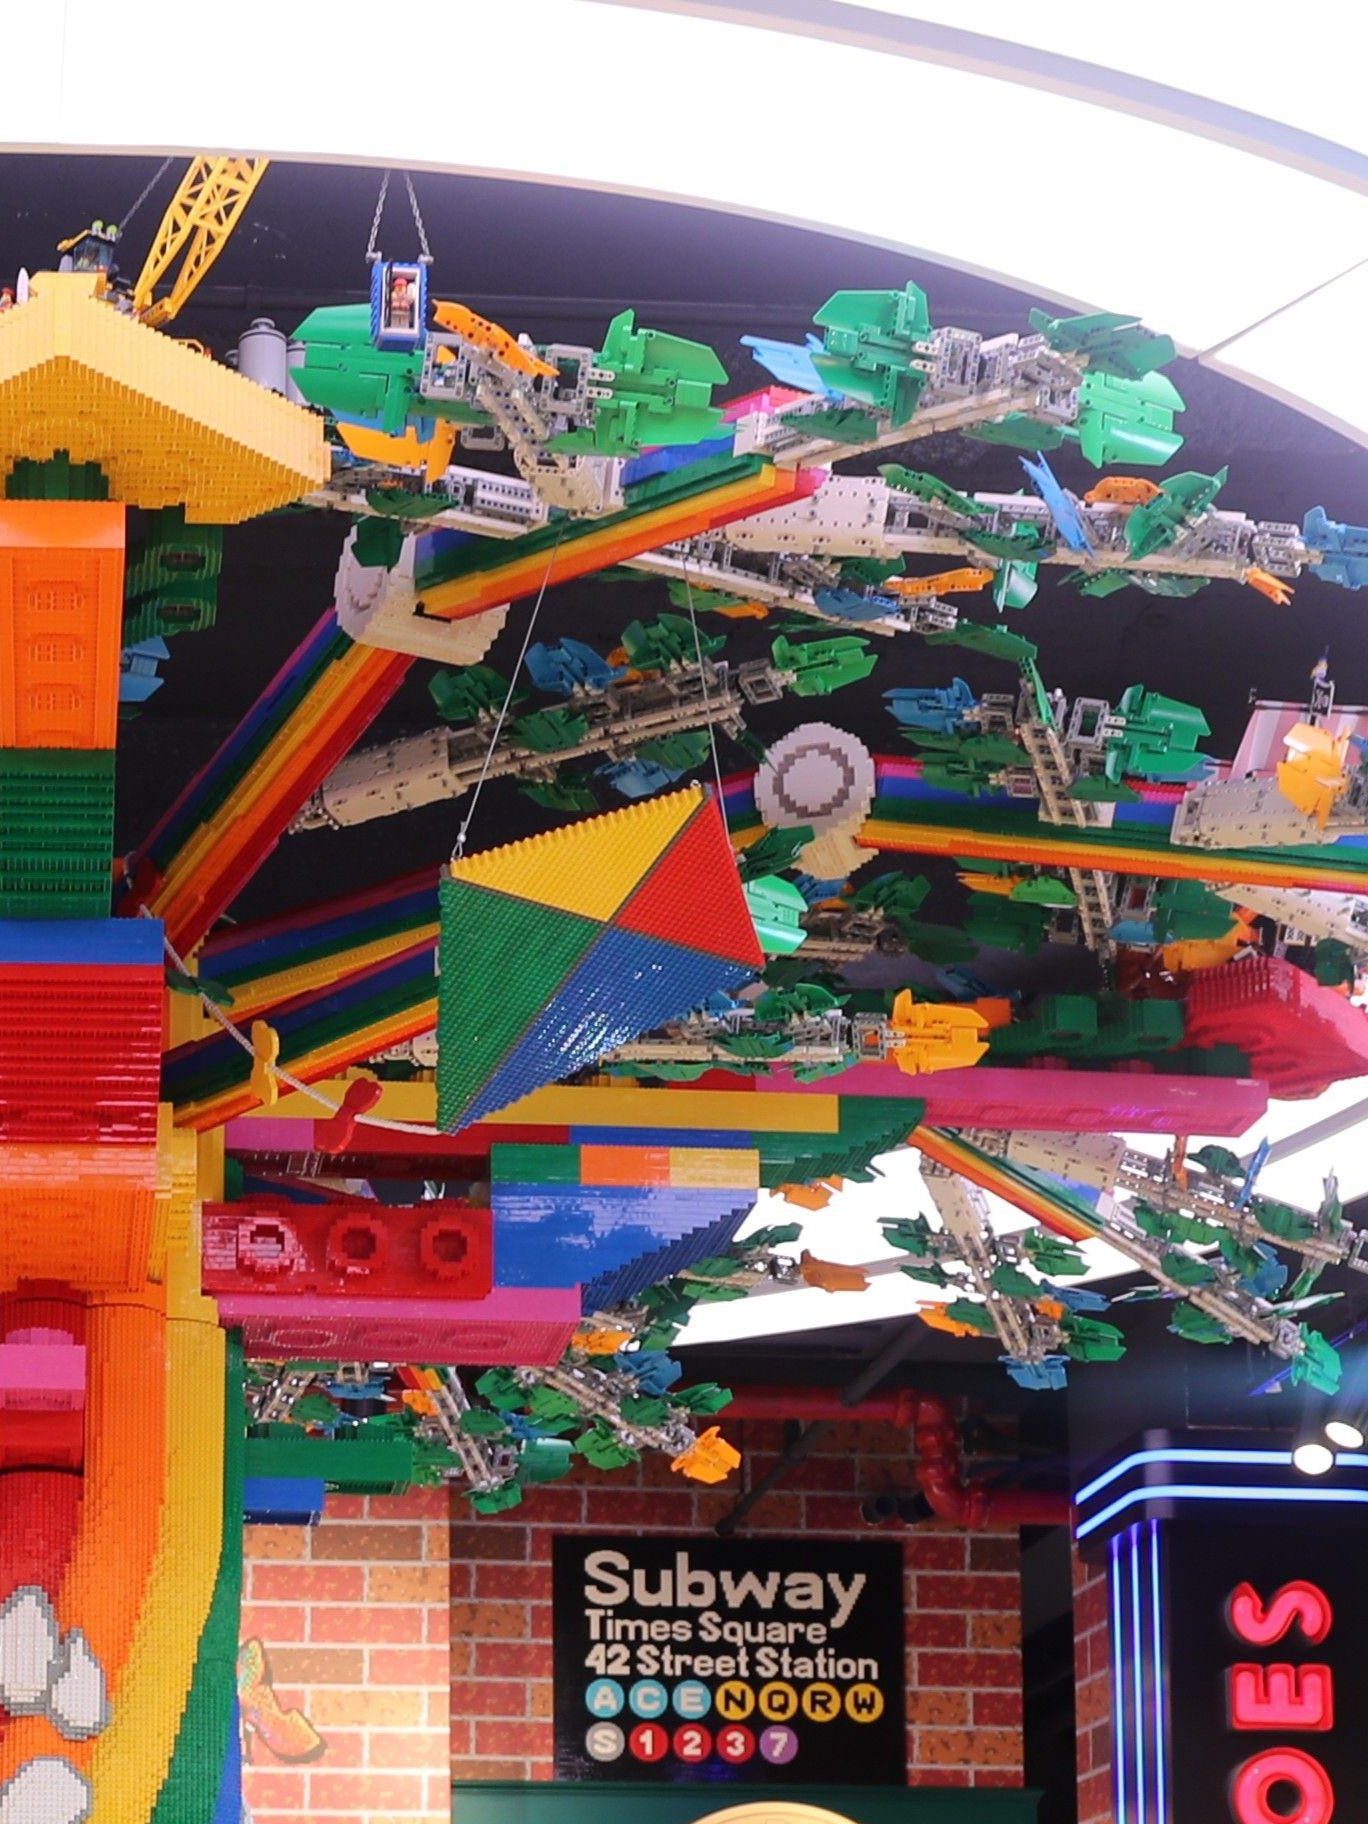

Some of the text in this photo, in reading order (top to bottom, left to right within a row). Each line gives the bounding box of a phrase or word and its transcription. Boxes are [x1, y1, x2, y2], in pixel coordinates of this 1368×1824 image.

[584, 1550, 866, 1628] Subway
[585, 1609, 827, 1647] Times Square
[584, 1643, 878, 1680] 42 Street Station
[593, 1686, 876, 1715] A C E N Q R W
[593, 1729, 788, 1758] S 1 2 3 7
